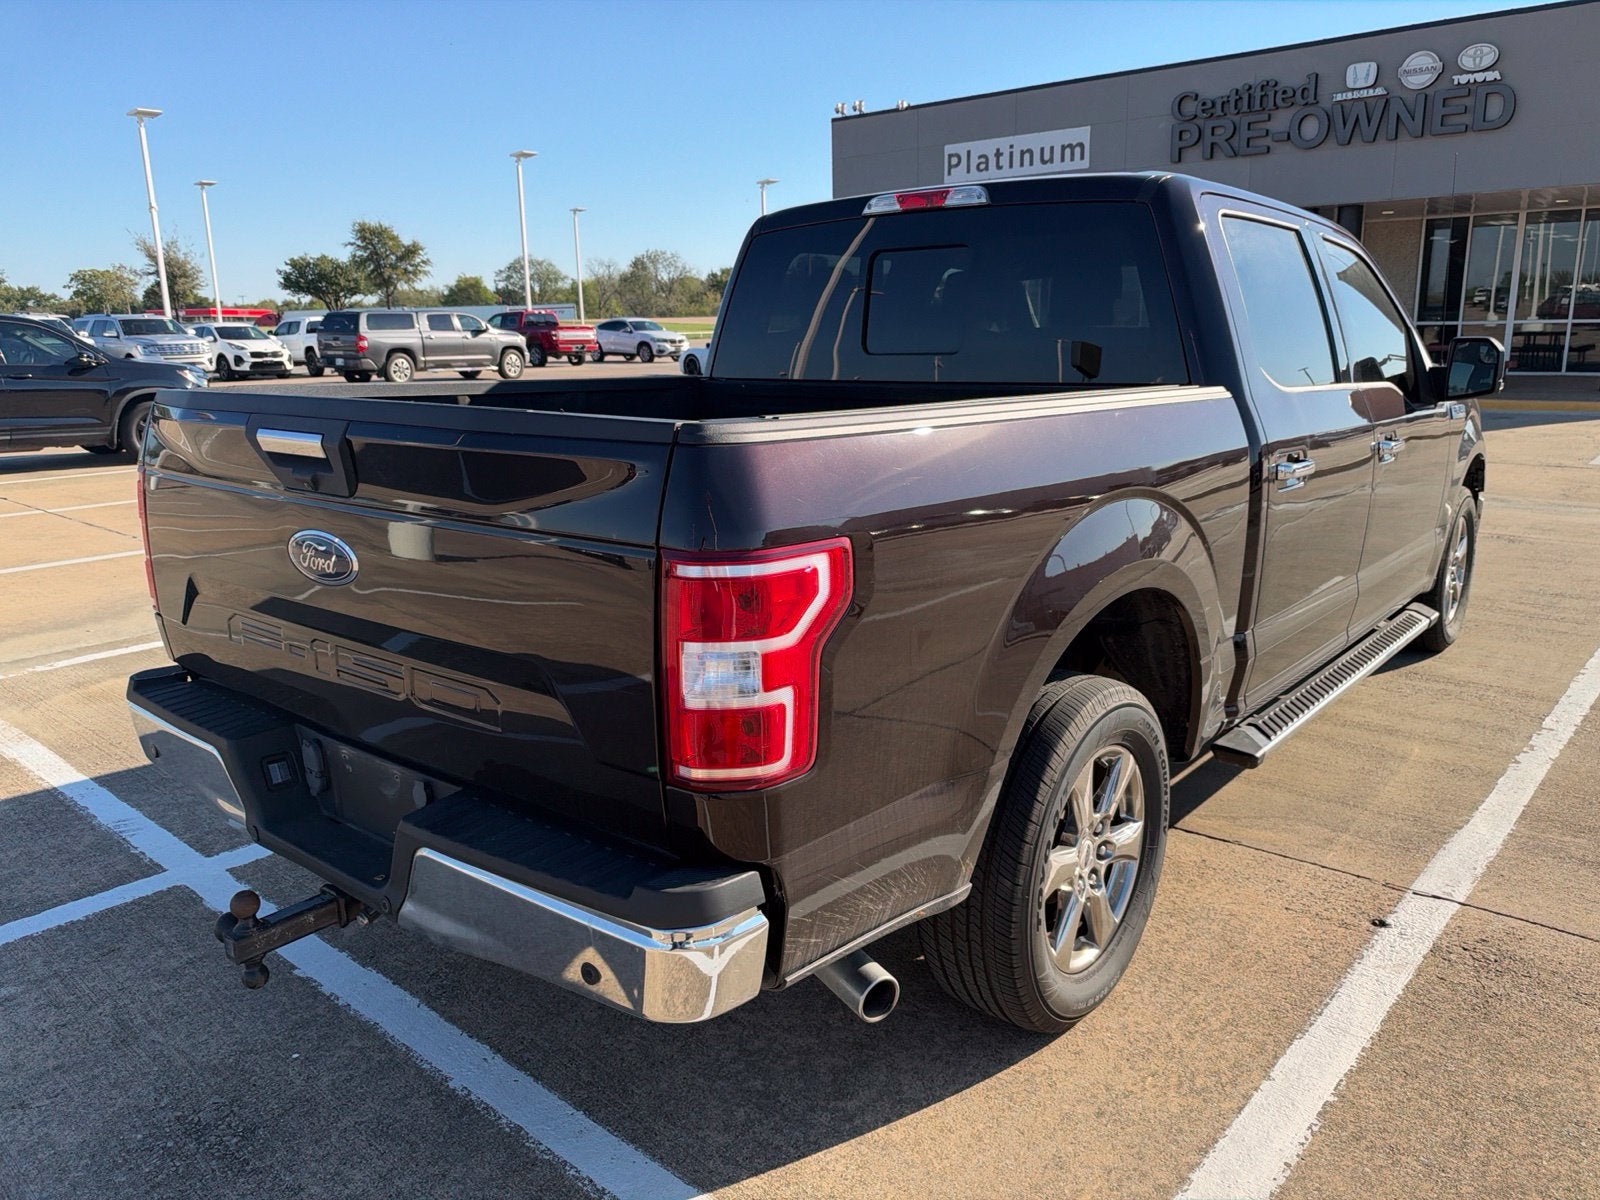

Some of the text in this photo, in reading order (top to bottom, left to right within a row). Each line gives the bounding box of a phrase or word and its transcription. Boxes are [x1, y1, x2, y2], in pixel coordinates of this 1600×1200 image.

[1402, 64, 1438, 75] NISSAN
[1171, 72, 1320, 122] Certified
[1170, 83, 1517, 163] PRE-OWNED
[947, 141, 1086, 177] Platinum
[300, 541, 337, 574] Ford
